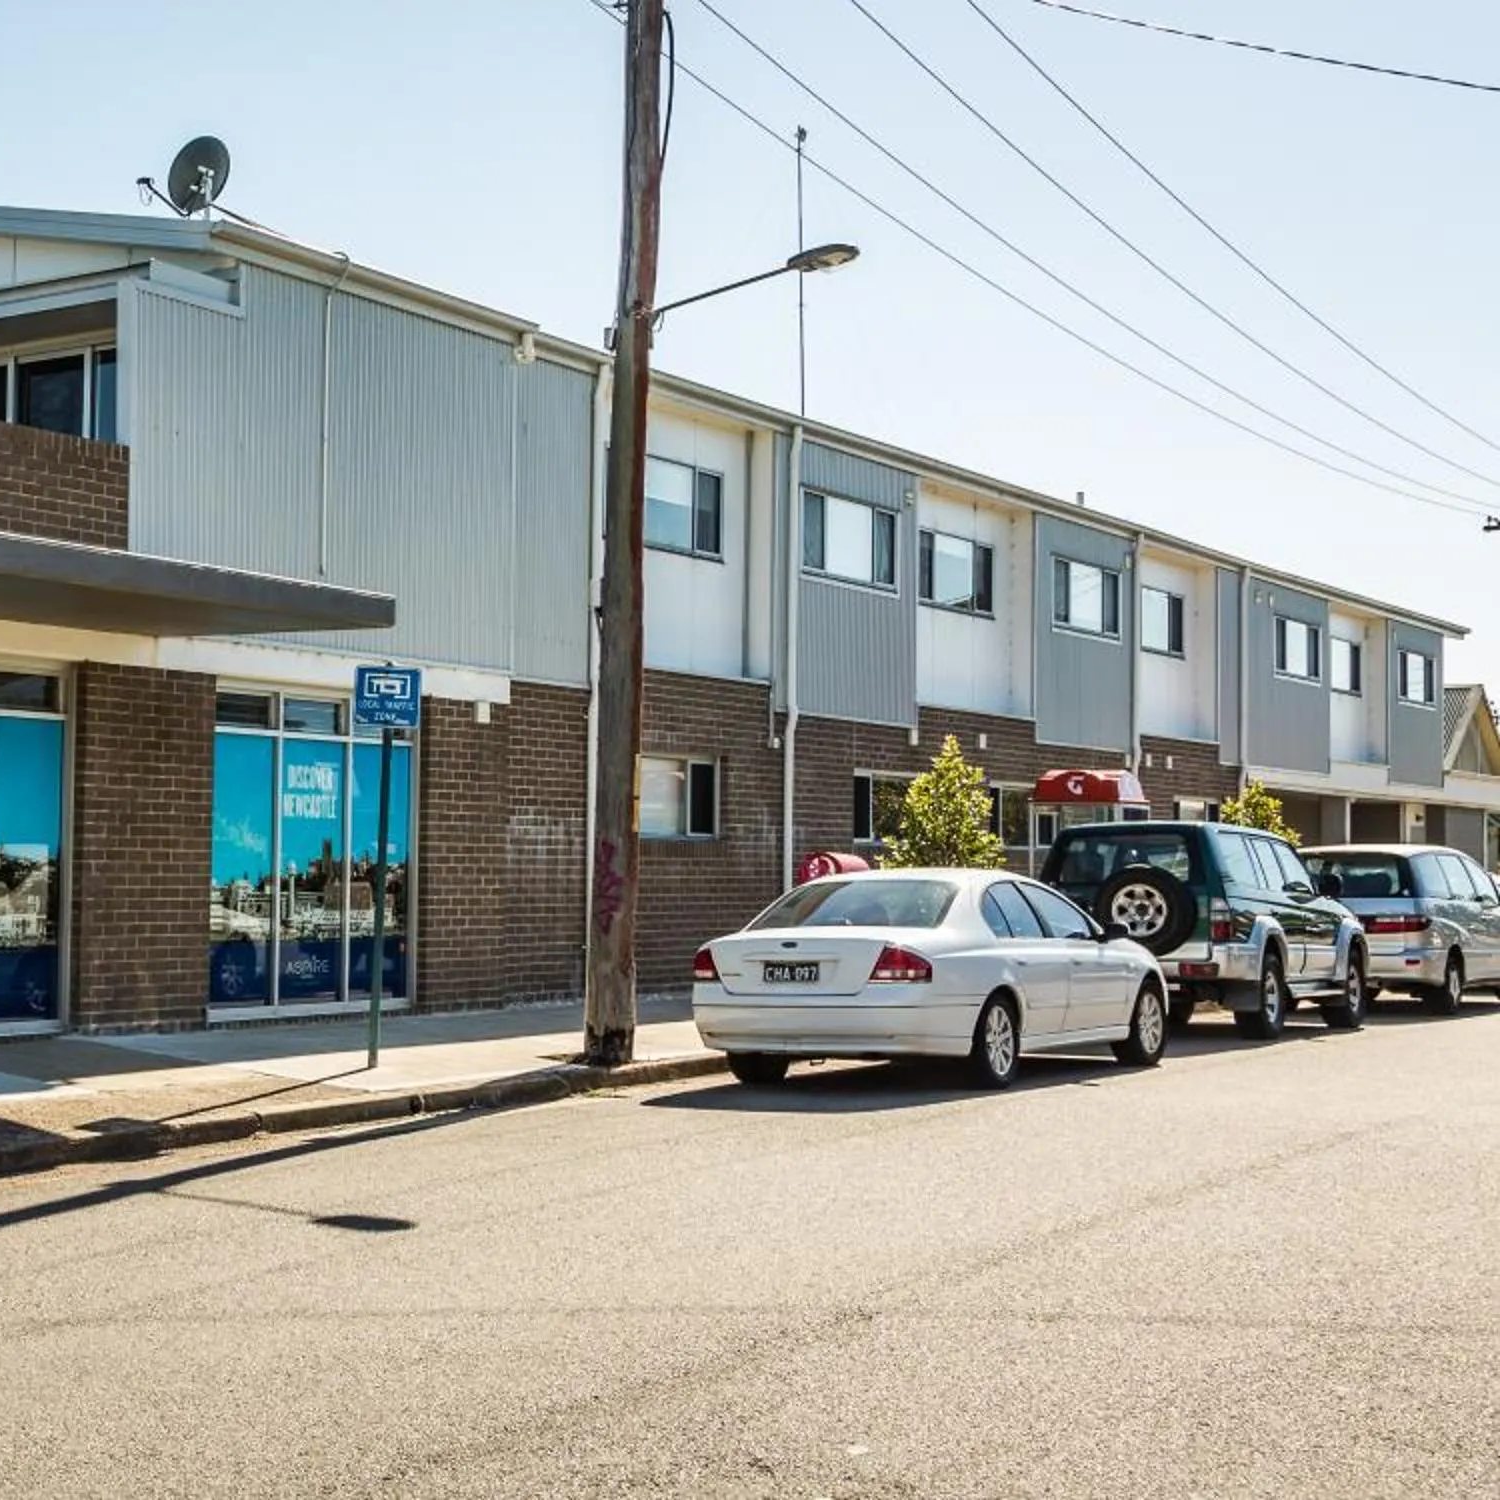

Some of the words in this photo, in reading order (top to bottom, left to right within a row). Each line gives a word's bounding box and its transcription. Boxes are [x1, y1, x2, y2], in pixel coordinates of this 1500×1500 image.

[287, 765, 333, 789] DISCOVER
[283, 793, 336, 818] NEWCASTLE
[285, 959, 330, 975] ASPIRE
